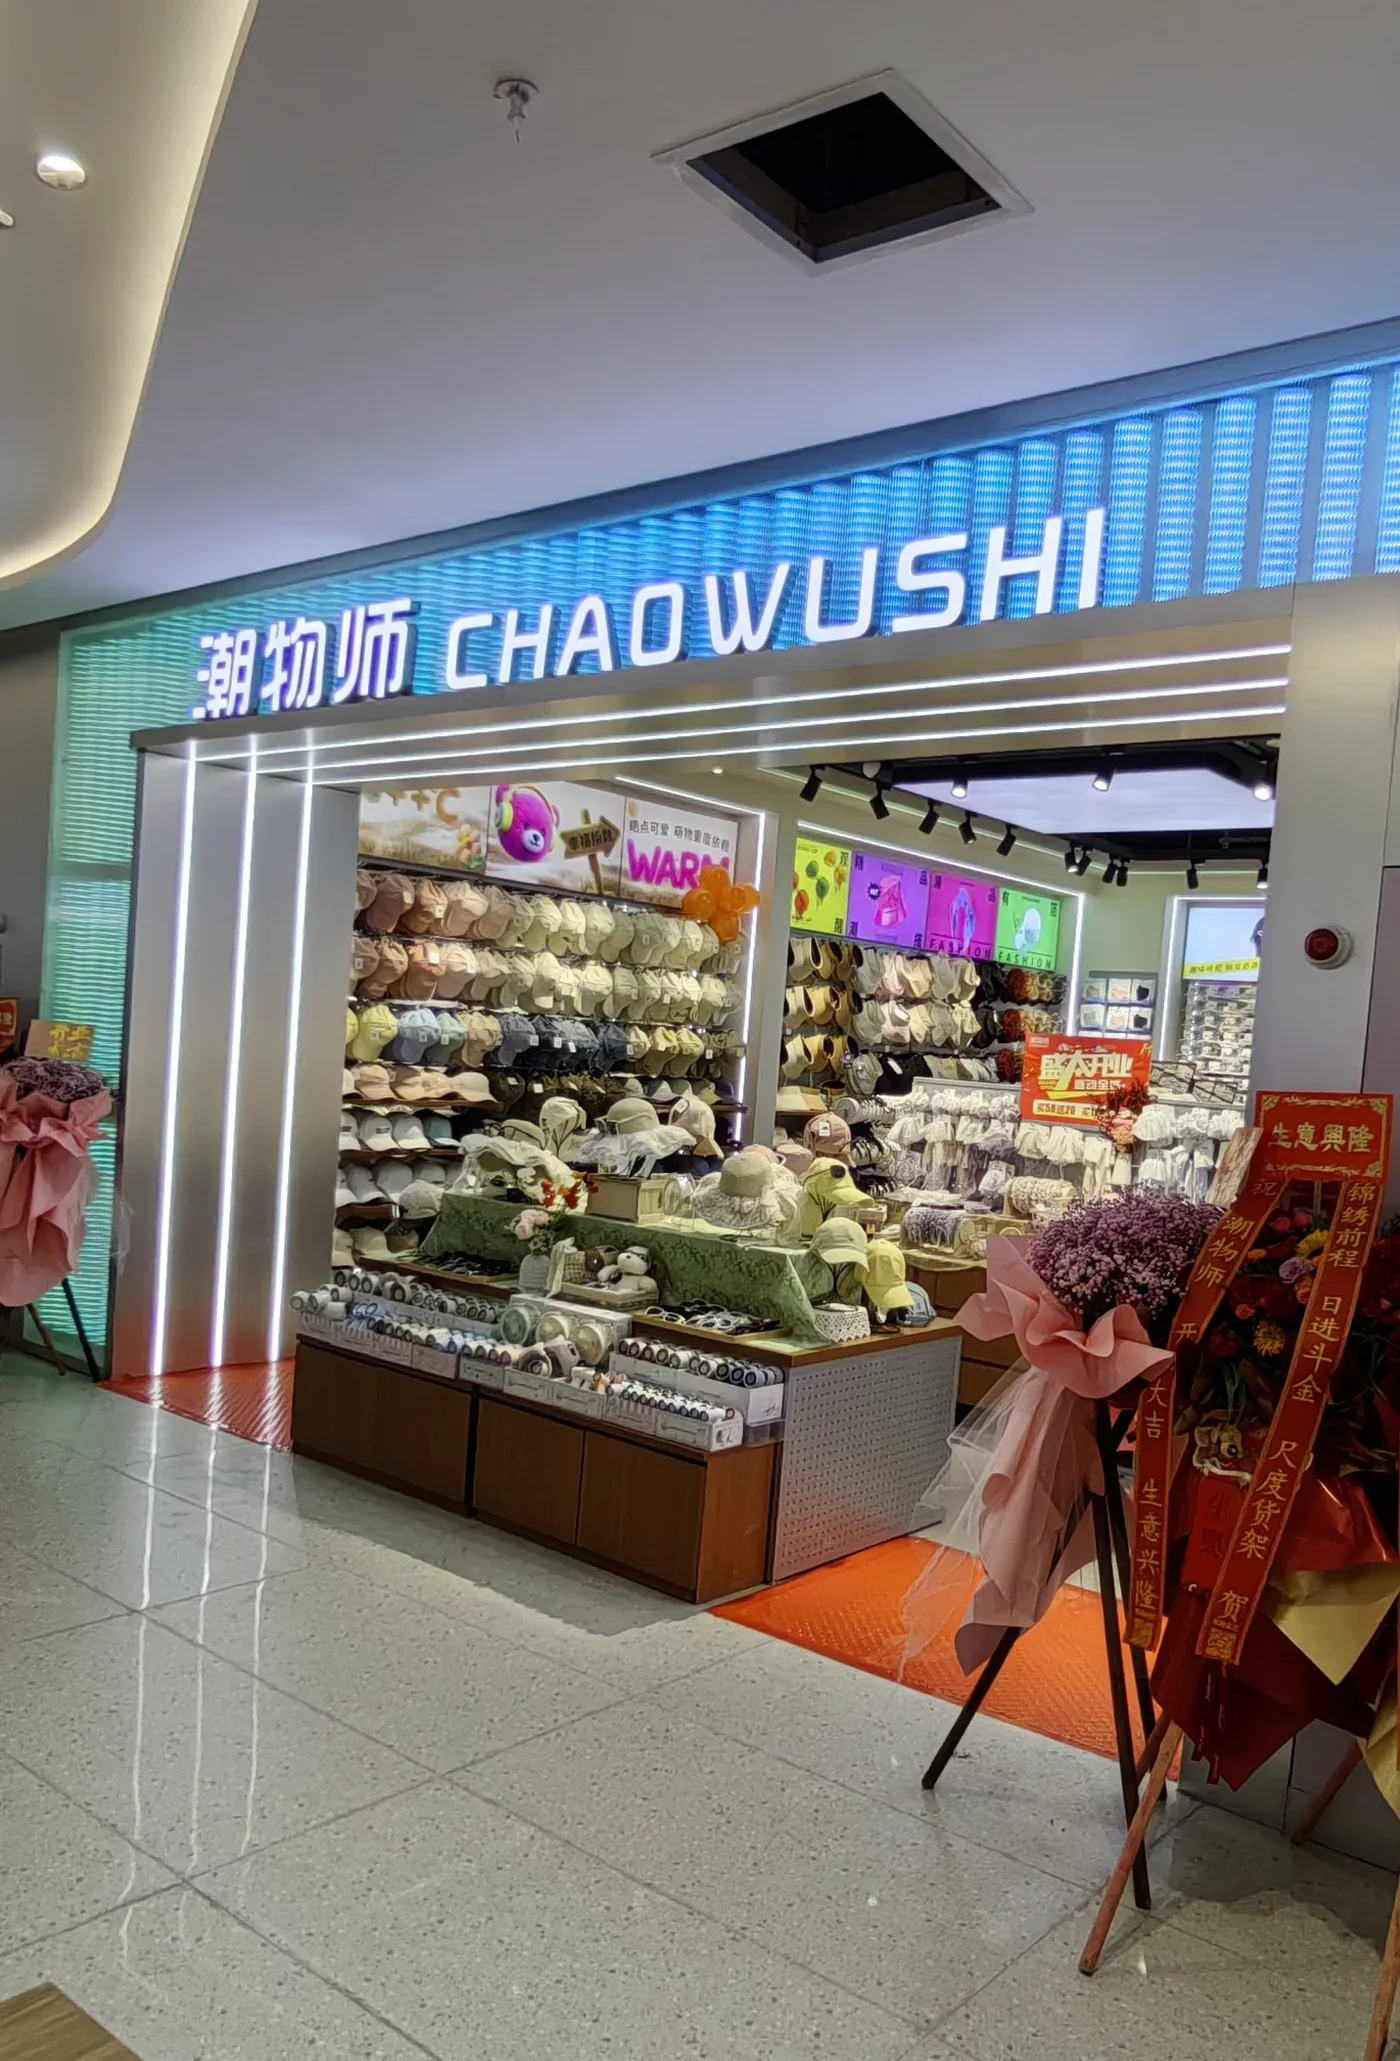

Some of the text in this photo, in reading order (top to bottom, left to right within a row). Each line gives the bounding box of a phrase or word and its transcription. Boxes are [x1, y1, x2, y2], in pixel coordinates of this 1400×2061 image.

[445, 508, 1107, 691] CHAOWUSHI
[192, 597, 418, 719] 潮物师
[929, 939, 992, 959] FASHION
[998, 952, 1052, 970] FASHION
[1038, 1049, 1134, 1091] 盛大开业
[1268, 1121, 1375, 1154] 生意興隆
[1194, 1215, 1255, 1289] 潮物师
[1327, 1183, 1376, 1269] 锦绣前程
[1291, 1295, 1343, 1404] 日进斗金
[1236, 1440, 1299, 1560] 尺度货架
[1134, 1478, 1163, 1609] 生意兴隆
[1218, 1589, 1250, 1622] 贺
